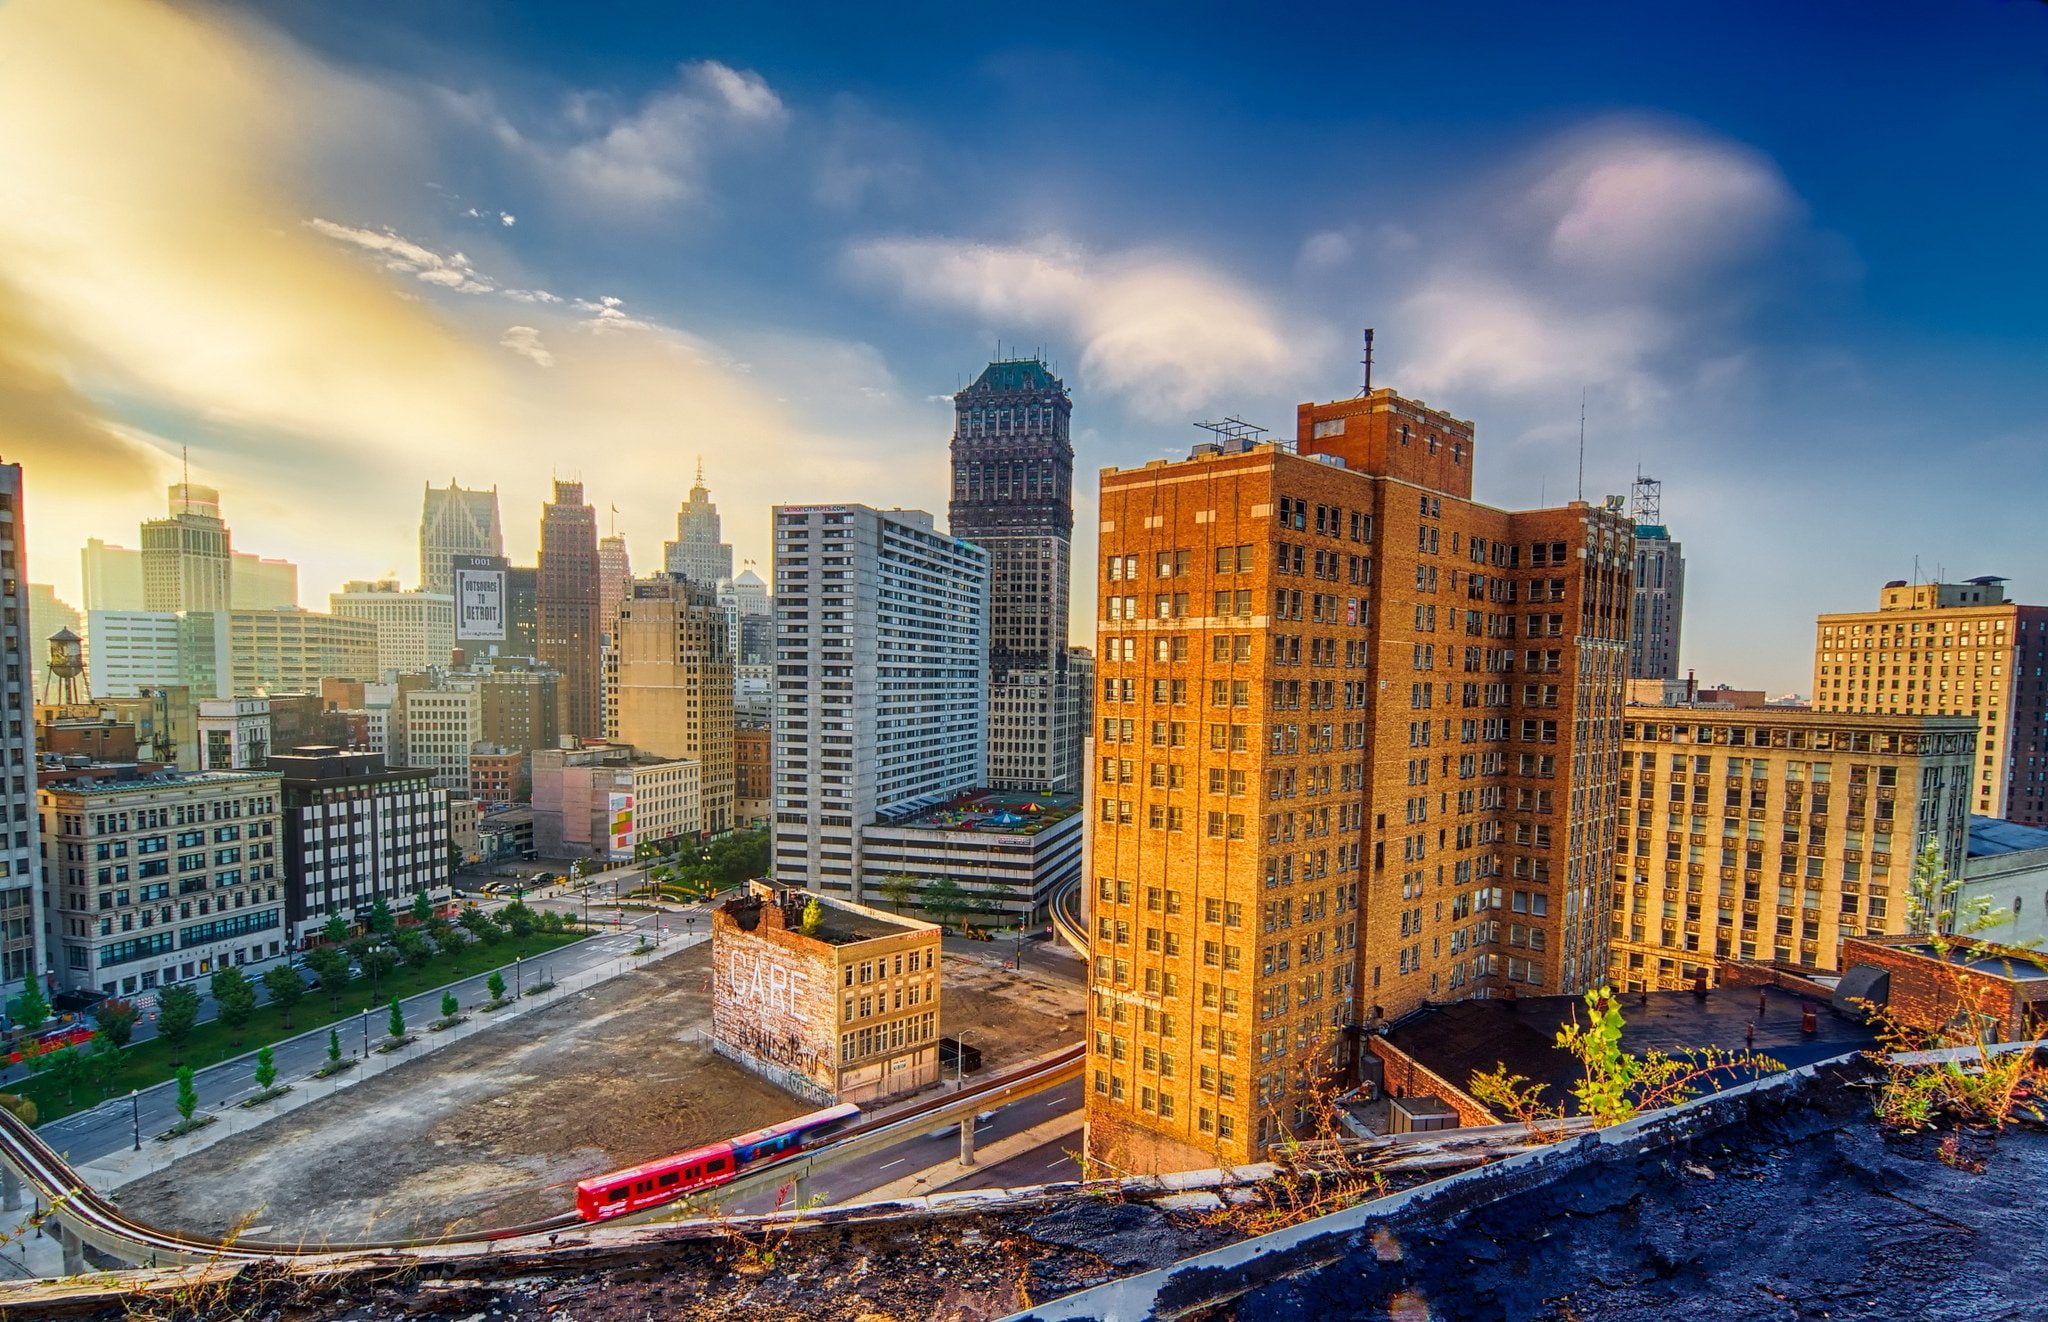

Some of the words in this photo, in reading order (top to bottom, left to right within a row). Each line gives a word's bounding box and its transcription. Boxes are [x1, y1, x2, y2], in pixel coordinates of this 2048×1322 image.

[470, 558, 490, 566] 1001
[465, 580, 497, 592] OUTSOURCE
[477, 593, 486, 605] TO
[466, 605, 497, 621] DETROIT
[730, 949, 809, 1023] CARE
